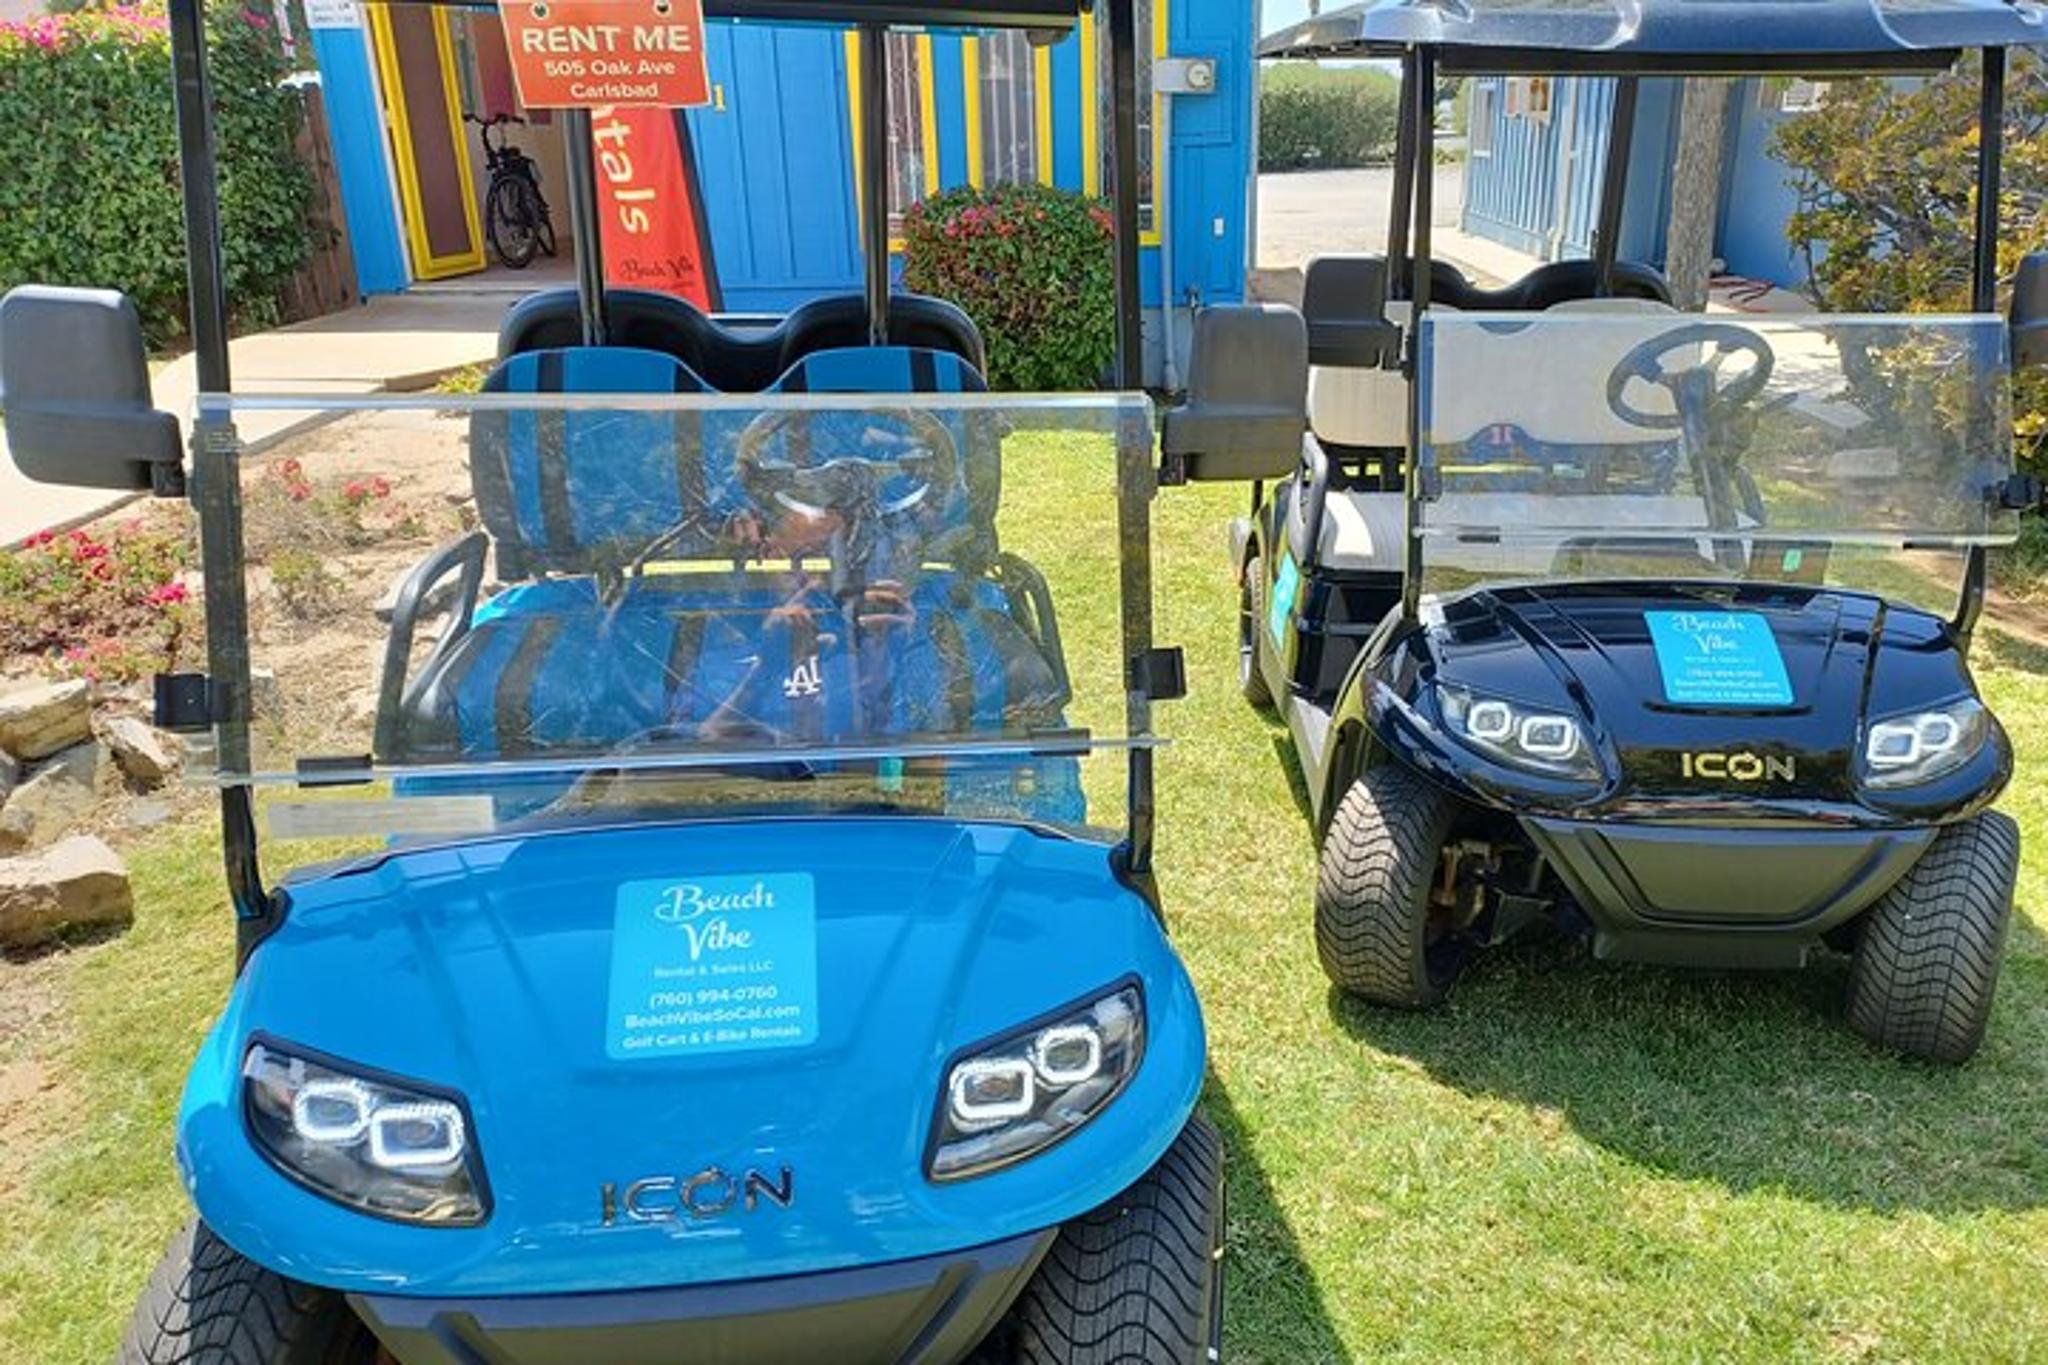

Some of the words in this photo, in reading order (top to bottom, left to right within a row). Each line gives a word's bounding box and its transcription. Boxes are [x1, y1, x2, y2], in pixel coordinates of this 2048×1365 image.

[522, 25, 621, 52] RENT
[633, 25, 691, 52] ME
[544, 60, 586, 76] 505
[591, 59, 632, 76] Oak
[637, 60, 676, 75] Ave
[570, 82, 659, 98] Carlsbad
[1672, 613, 1744, 632] Beach
[1693, 632, 1738, 654] Vibe
[1682, 752, 1796, 782] ICON
[654, 880, 775, 922] Beach
[679, 916, 755, 961] Vibe
[654, 967, 695, 979] Rental
[712, 963, 746, 975] Sales
[751, 960, 774, 973] LLC
[651, 990, 693, 1010] (760)
[625, 1005, 801, 1029] BeachVibeSoCal.com
[622, 1034, 653, 1049] Golf
[656, 1033, 687, 1047] Cart
[689, 1030, 700, 1045] &
[750, 1024, 803, 1040] Rentals
[602, 1162, 794, 1227] ICON
